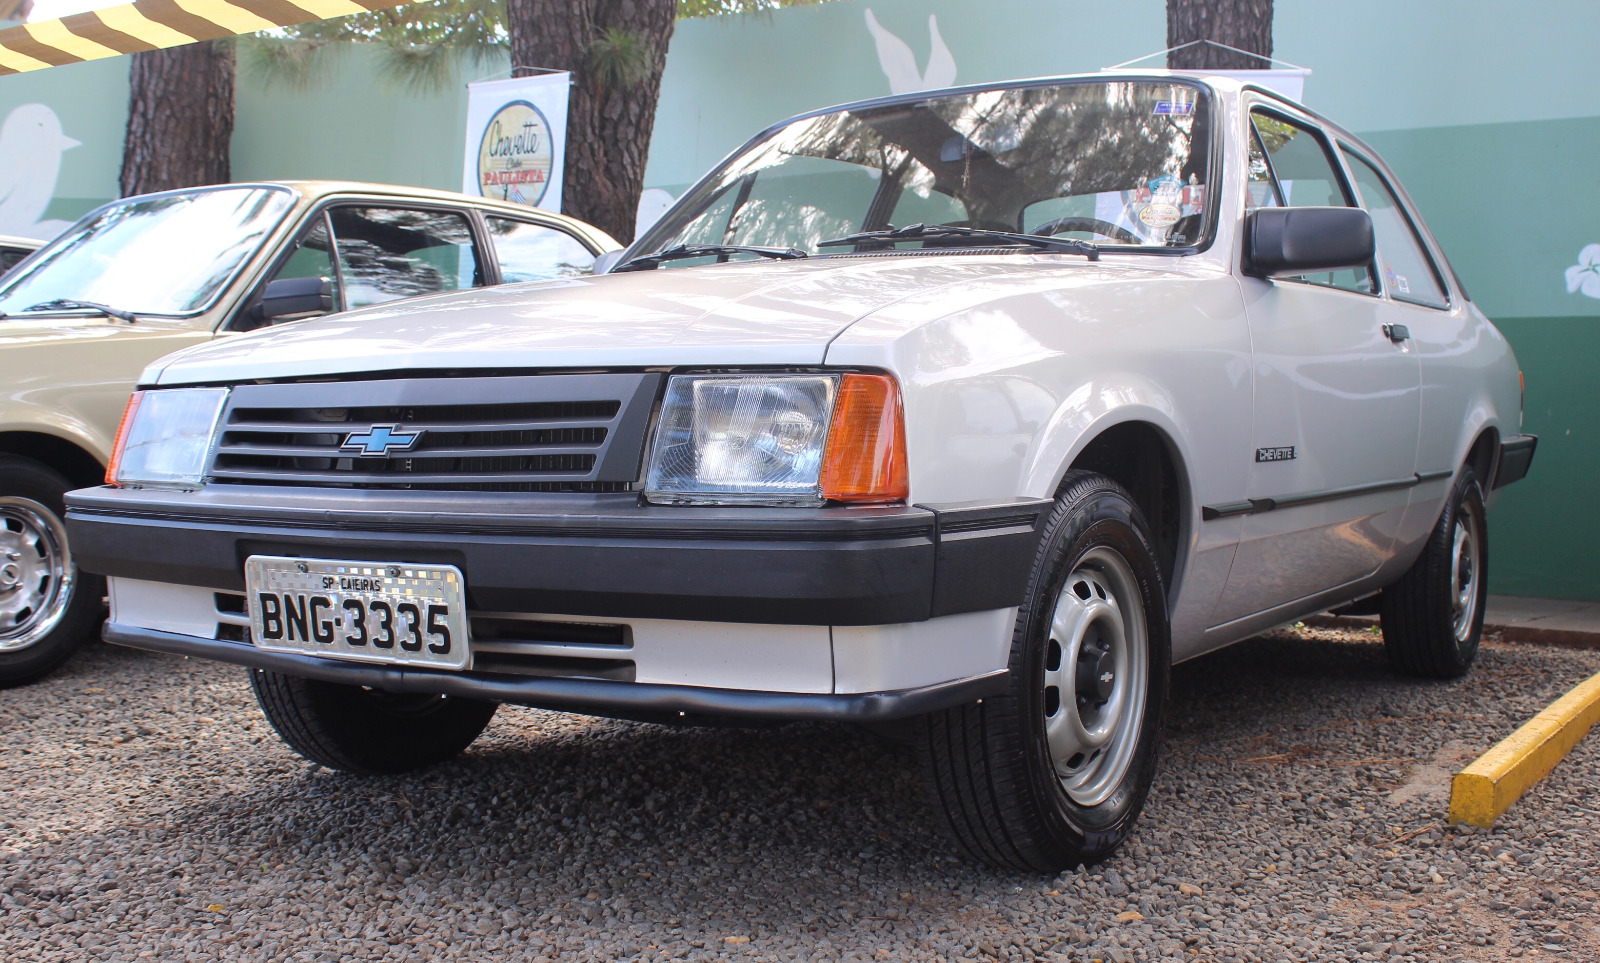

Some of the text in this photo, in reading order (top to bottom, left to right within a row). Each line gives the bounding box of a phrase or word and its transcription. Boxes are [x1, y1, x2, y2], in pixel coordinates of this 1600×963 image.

[489, 120, 539, 157] Chevette
[484, 169, 544, 185] PAULISTA
[1258, 447, 1293, 462] CHEVETTE
[322, 576, 335, 589] SP
[340, 577, 381, 592] CAIEIRAS
